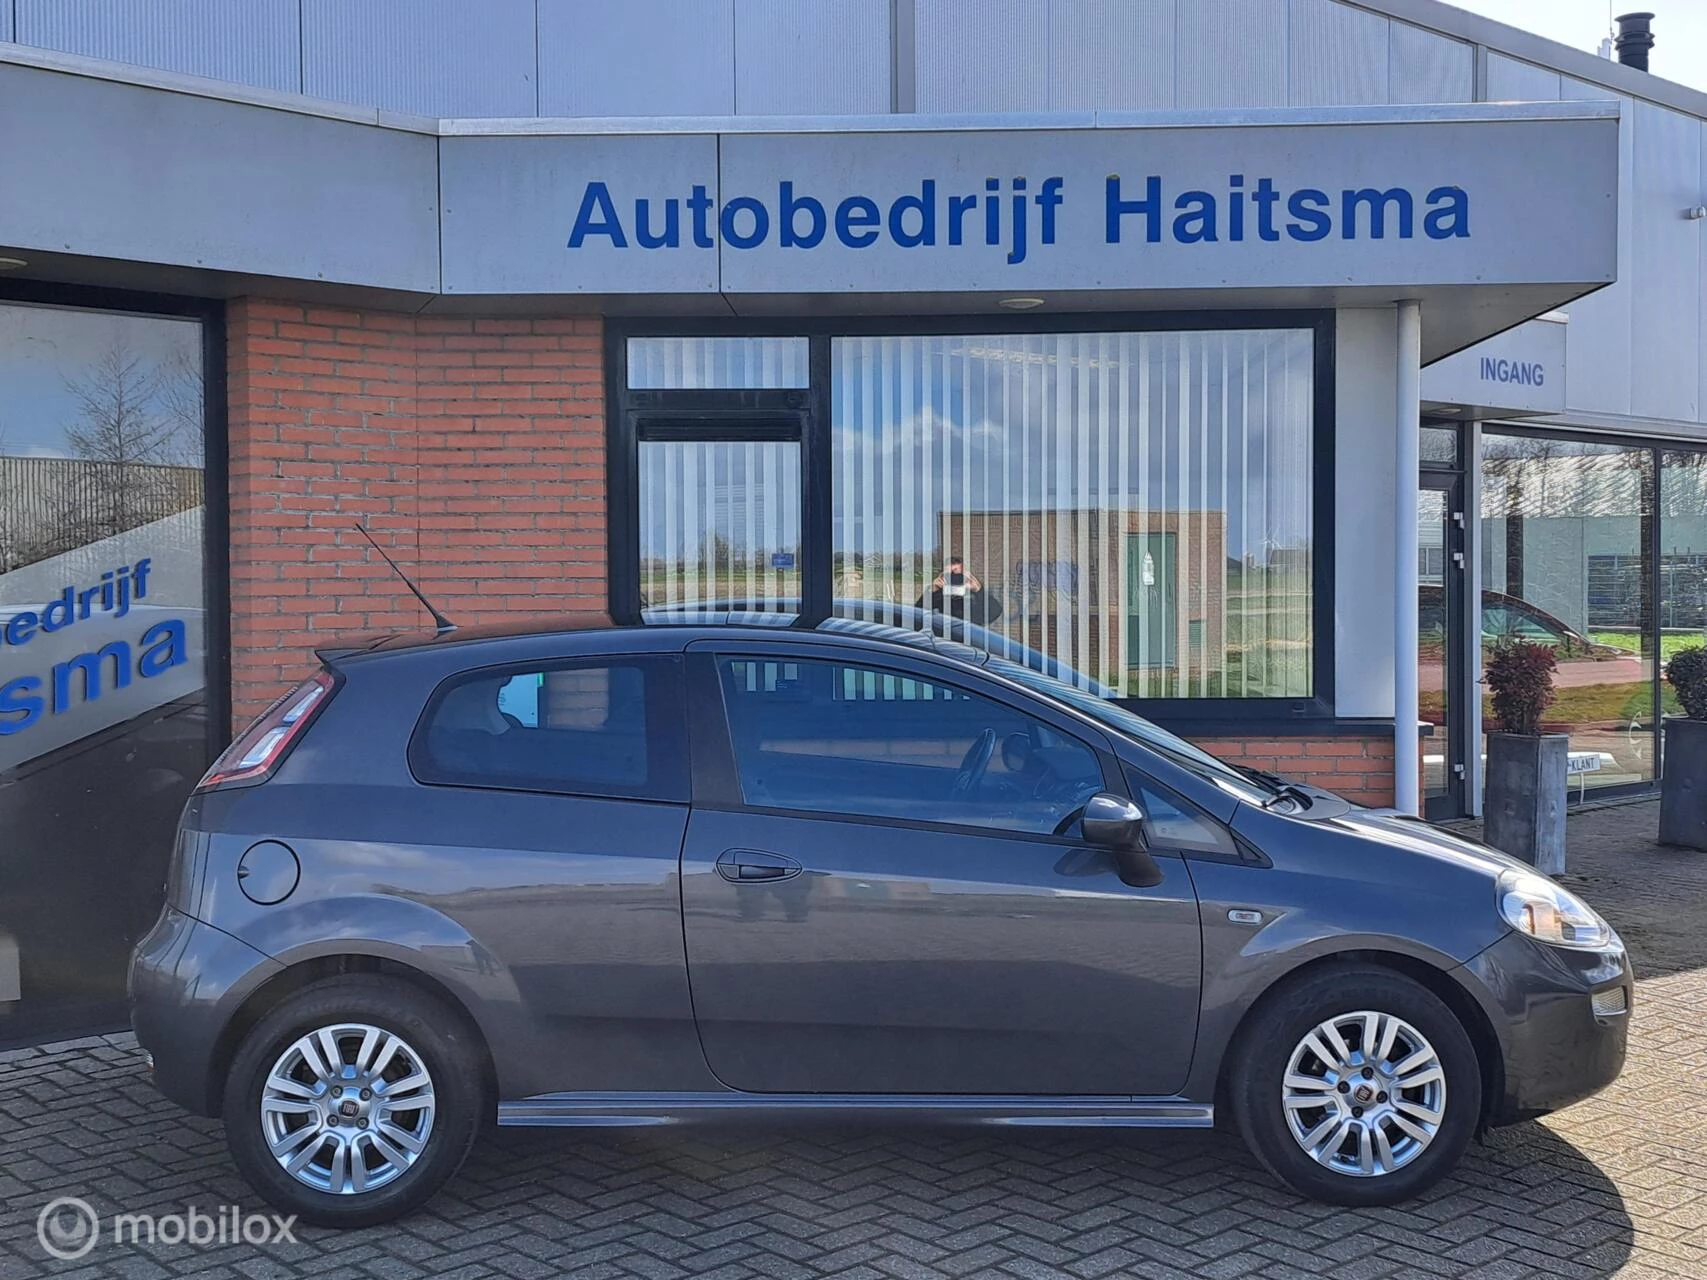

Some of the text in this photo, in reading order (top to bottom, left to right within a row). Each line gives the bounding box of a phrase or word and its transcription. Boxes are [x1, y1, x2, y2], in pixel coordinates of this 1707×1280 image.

[566, 174, 1471, 265] Autobedrijf Haitsma
[1480, 357, 1544, 386] INGANG
[0, 558, 152, 645] edrijf
